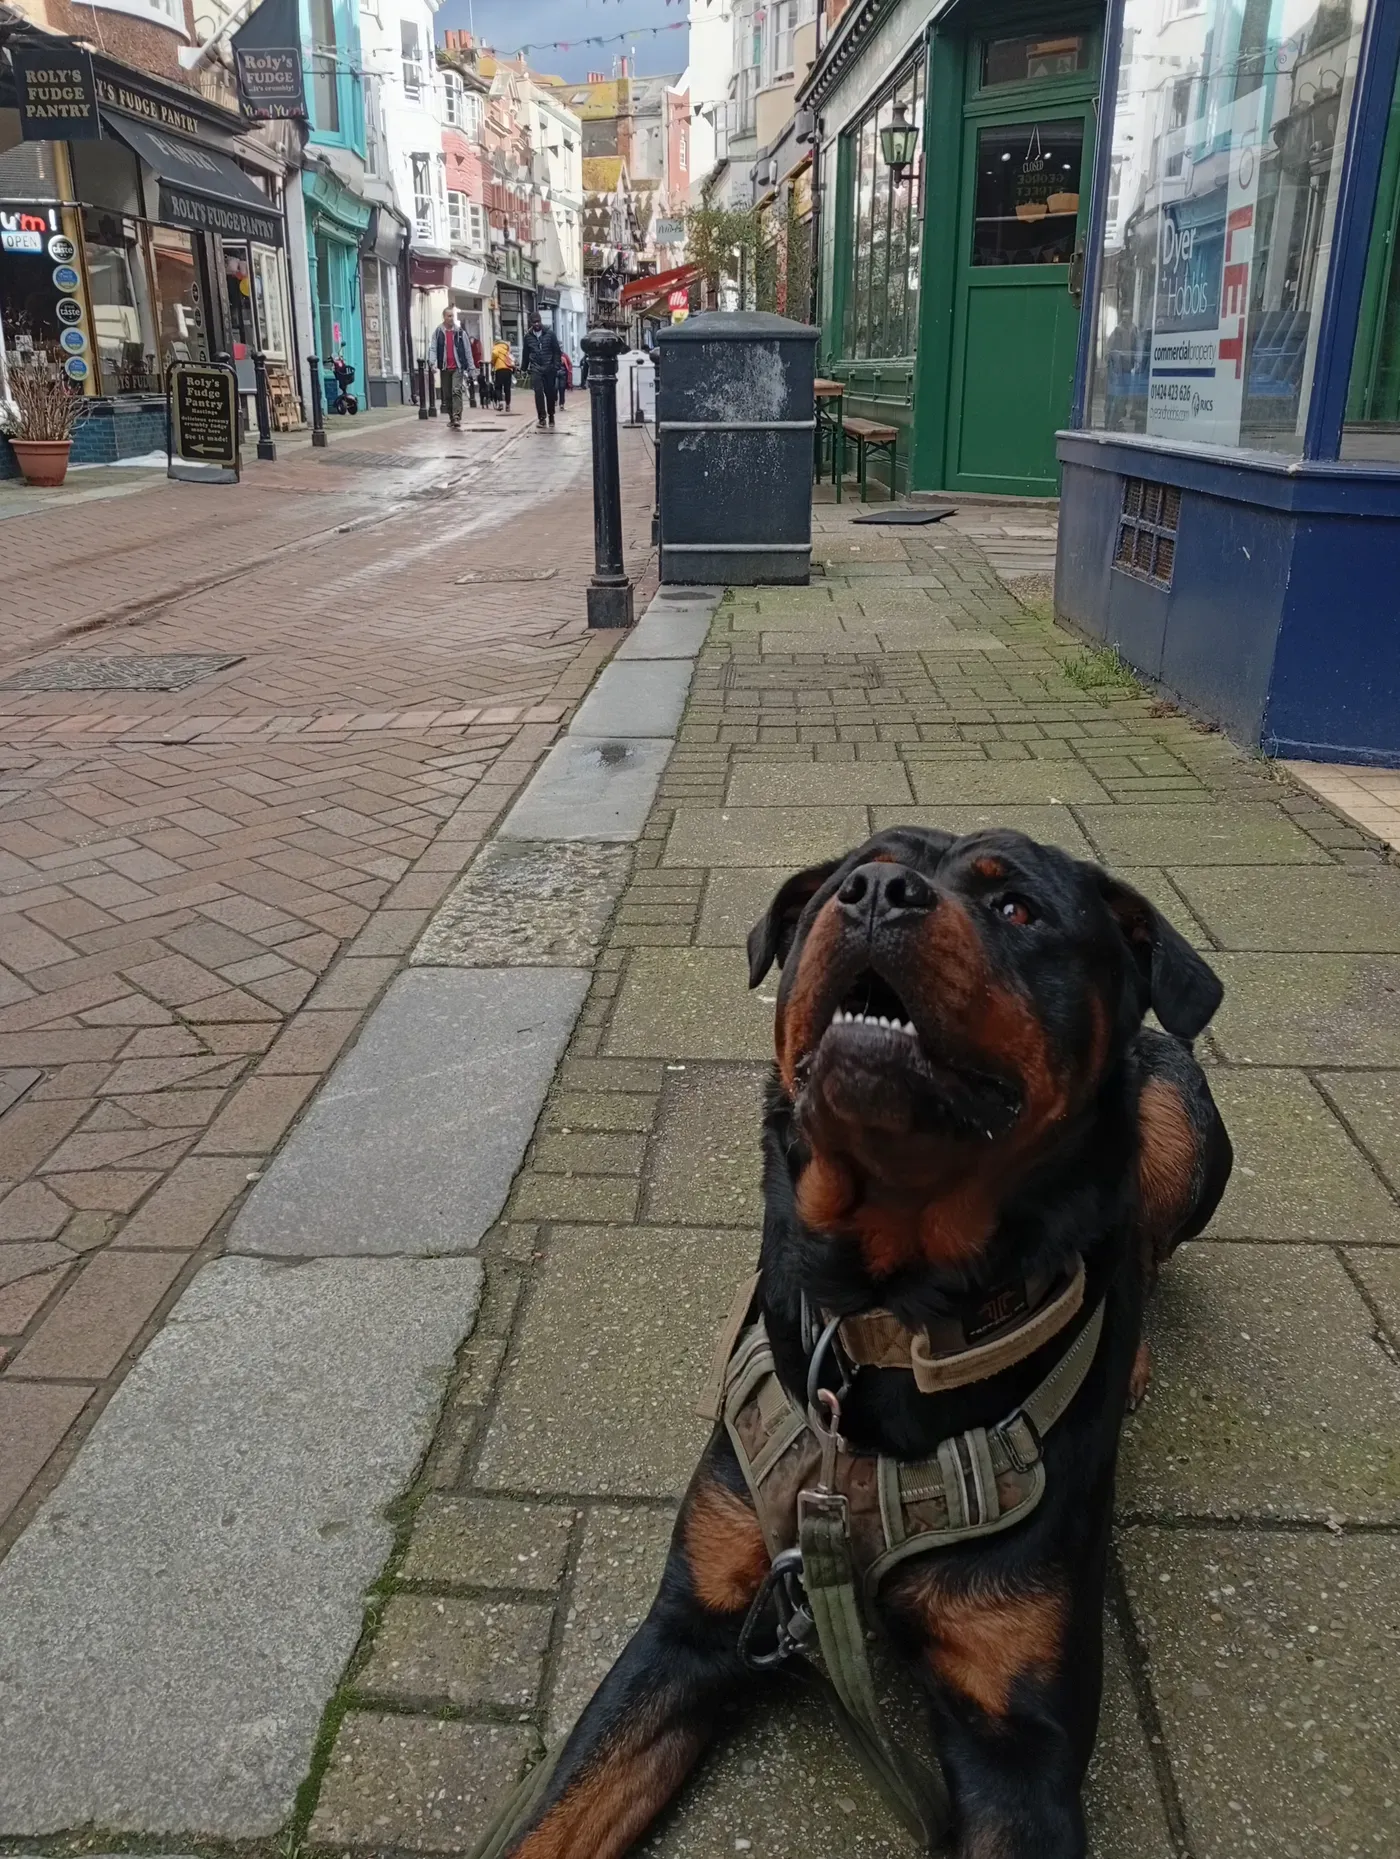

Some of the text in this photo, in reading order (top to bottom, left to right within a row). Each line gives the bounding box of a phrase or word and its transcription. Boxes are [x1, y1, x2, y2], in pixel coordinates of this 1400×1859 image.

[244, 55, 293, 71] Roly's
[25, 70, 82, 83] ROLY'S
[246, 72, 293, 84] FUDGE
[27, 87, 85, 100] FUDGE
[25, 104, 91, 117] PANTRY
[119, 88, 157, 117] FUDGE
[161, 105, 198, 133] PANTRY
[1022, 160, 1044, 173] CLOSED
[171, 196, 274, 239] ROLY'S FUDGE PANTRY
[6, 235, 37, 248] OPEN
[1162, 218, 1197, 275] Dyer
[1218, 203, 1253, 380] LET
[669, 291, 688, 309] illy
[60, 308, 81, 317] taste
[186, 376, 220, 388] Roly's
[187, 387, 220, 399] Fudge
[1150, 384, 1191, 401] 01424 423 626
[184, 397, 223, 410] Pantry
[1200, 399, 1214, 412] RICS
[192, 408, 218, 416] Hastings
